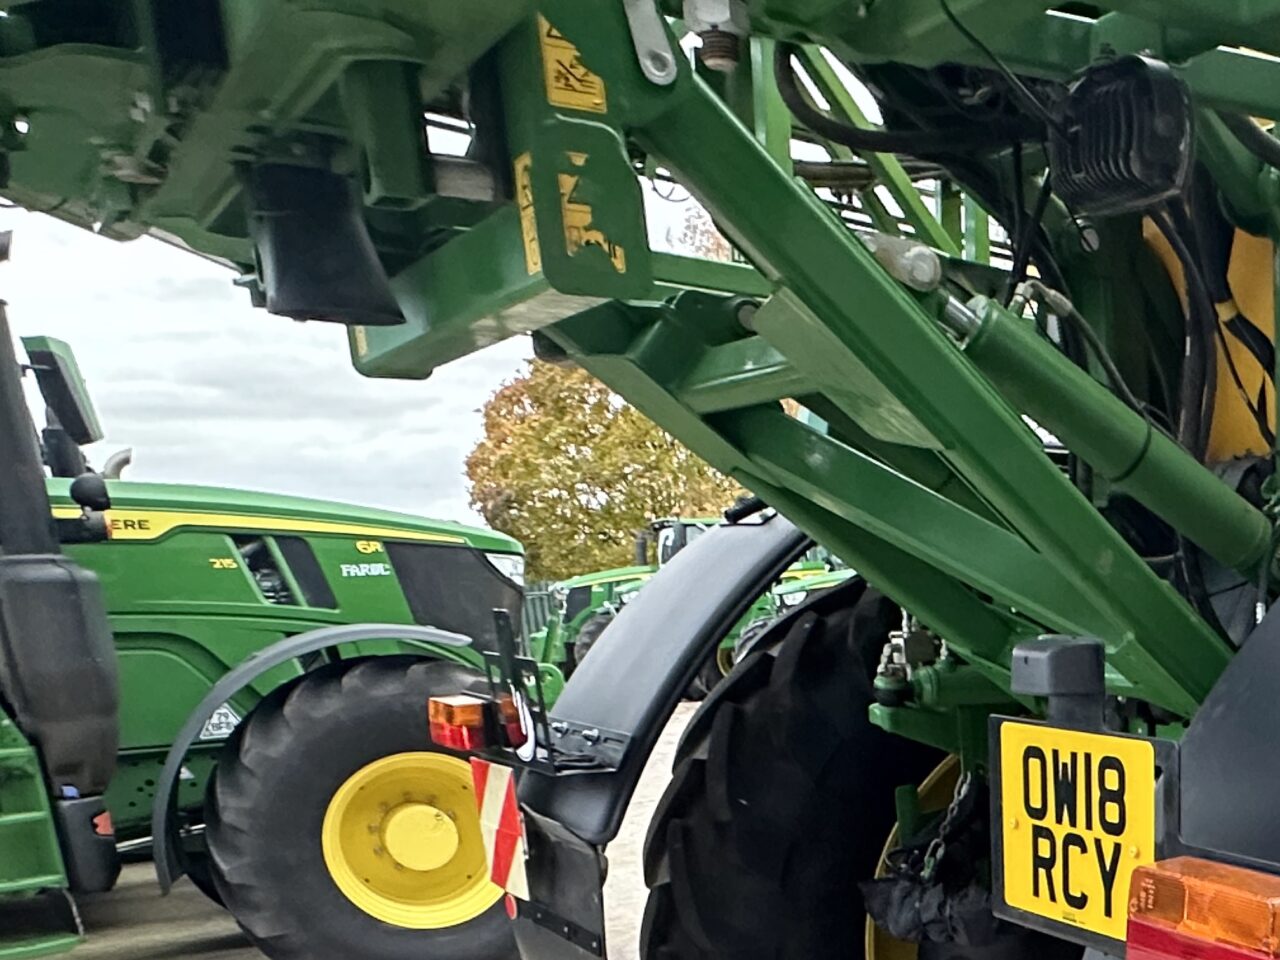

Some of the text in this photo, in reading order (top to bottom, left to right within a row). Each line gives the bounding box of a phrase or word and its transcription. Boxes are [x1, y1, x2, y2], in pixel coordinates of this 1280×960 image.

[110, 519, 151, 530] ERE
[355, 540, 384, 554] 6R
[209, 558, 238, 569] 215
[1023, 745, 1127, 837] OW18
[1032, 824, 1122, 918] RCY
